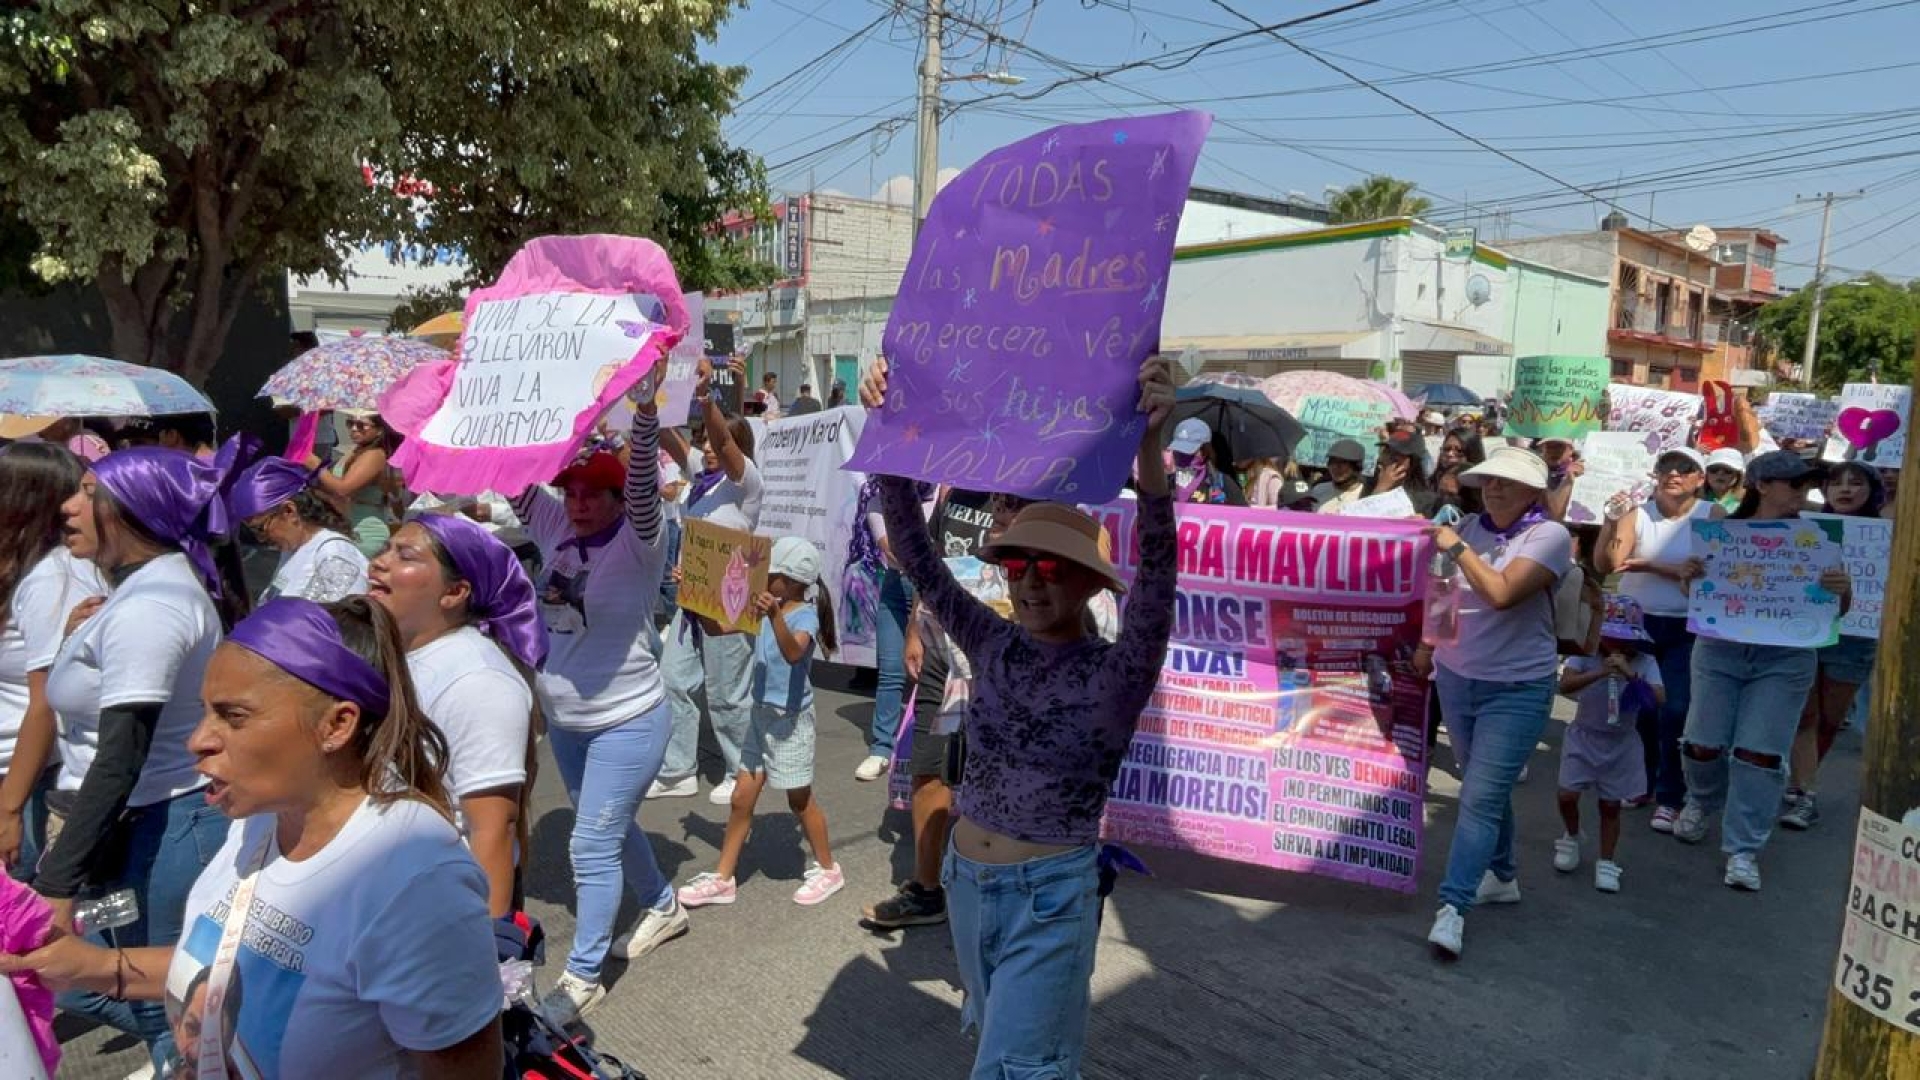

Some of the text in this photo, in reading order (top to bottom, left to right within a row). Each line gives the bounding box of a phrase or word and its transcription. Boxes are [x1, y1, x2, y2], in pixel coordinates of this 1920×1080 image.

[972, 159, 1113, 208] TODAS
[917, 238, 1148, 304] las Madres
[472, 294, 618, 332] VIVA SE LA
[480, 329, 588, 364] LLEVARON
[895, 321, 1052, 364] merecen
[458, 372, 542, 408] VIVA LA
[890, 377, 1113, 441] a sus hijas
[450, 408, 564, 447] QUEREMOS
[1234, 527, 1414, 593] MAYLIN!
[1722, 547, 1810, 562] MUJERES
[1725, 604, 1792, 619] LA MIA
[1171, 648, 1245, 677] IVA!
[1170, 719, 1190, 739] DEL
[1205, 700, 1219, 717] LA
[1220, 701, 1272, 726] JUSTICIA
[1226, 756, 1246, 780] DE
[1248, 759, 1266, 783] LA
[1300, 752, 1322, 774] LOS
[1325, 754, 1351, 779] VES
[1353, 759, 1421, 795] DENUNCIA!
[1147, 770, 1269, 822] MORELOS!
[1308, 784, 1389, 815] PERMITAMOS
[1391, 799, 1413, 821] QUE
[1273, 803, 1287, 822] EL
[1290, 806, 1384, 842] CONOCIMIENTO
[1386, 820, 1417, 851] LEGAL
[1273, 831, 1312, 857] SIRVA
[1313, 840, 1323, 859] A
[1325, 841, 1341, 863] LA
[1343, 844, 1416, 878] IMPUNIDAD!
[1850, 885, 1920, 940] BACH
[1839, 952, 1894, 1011] 735
